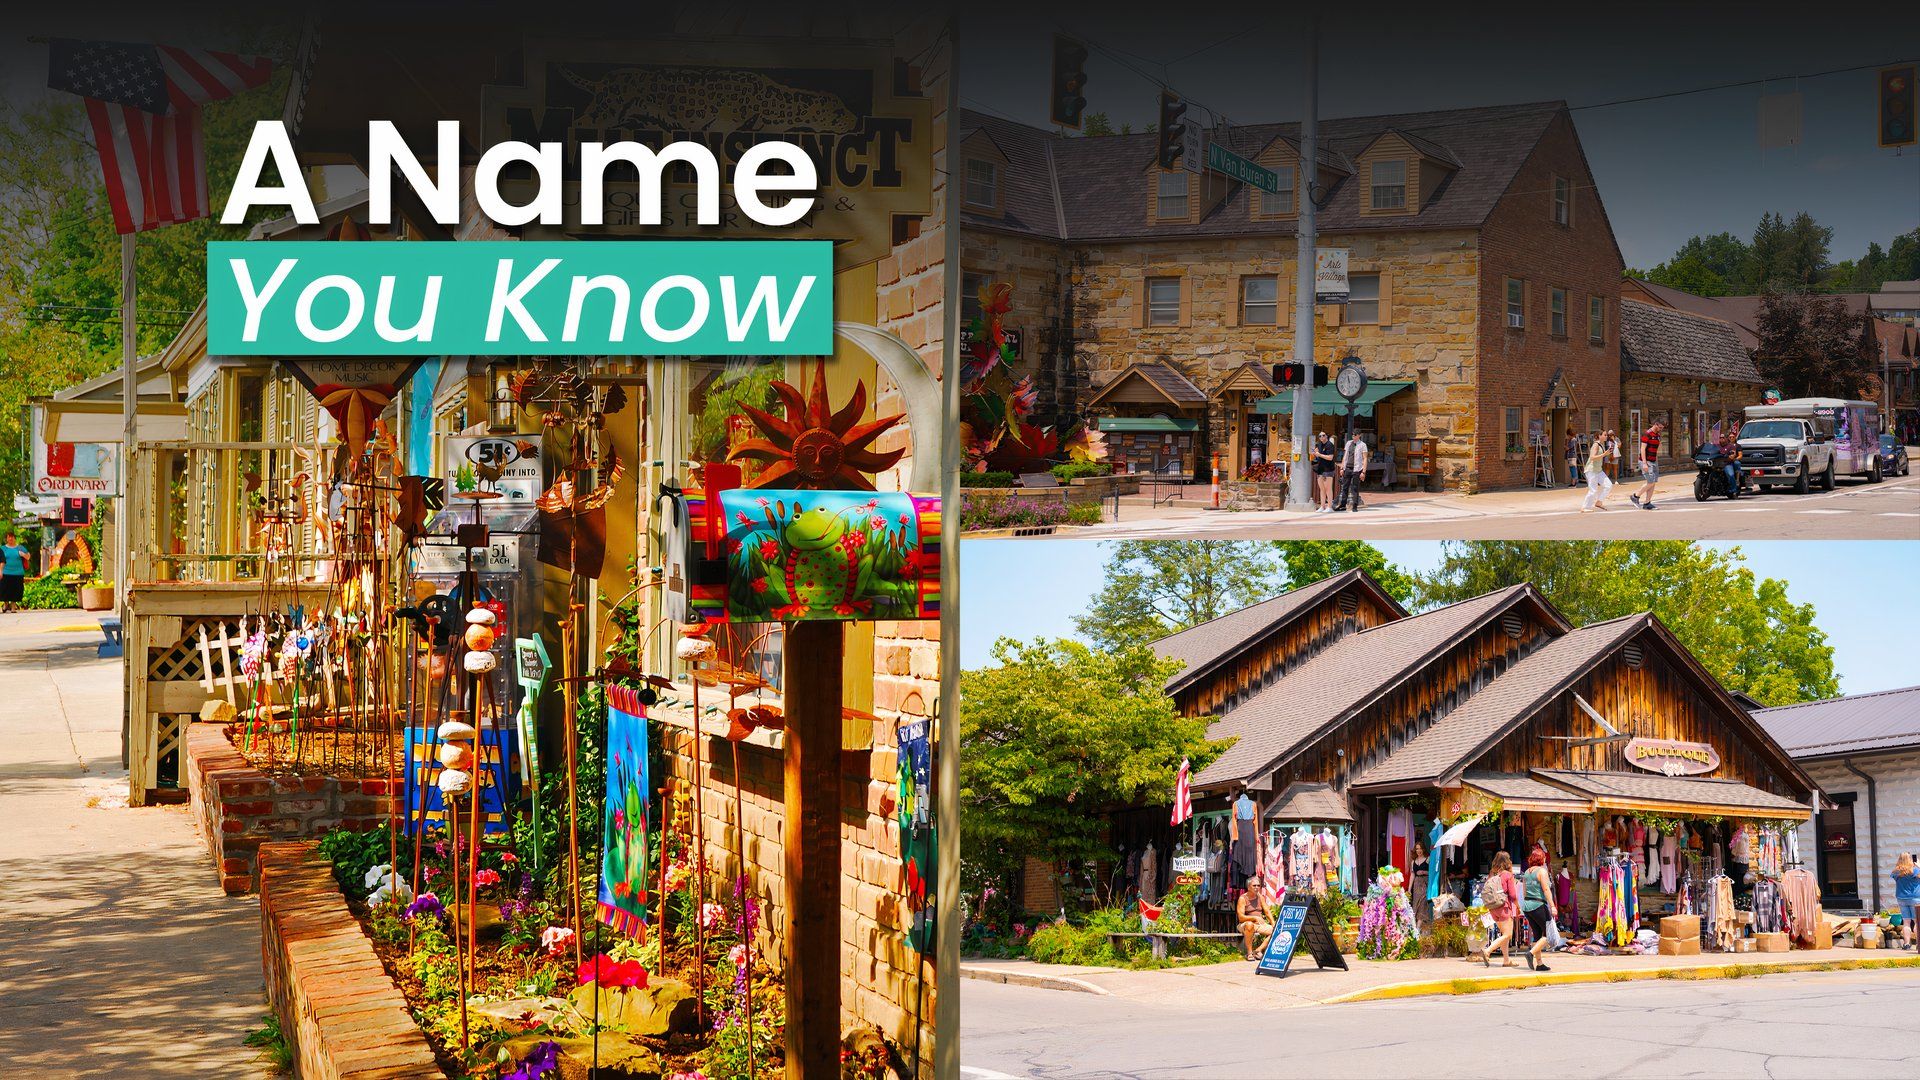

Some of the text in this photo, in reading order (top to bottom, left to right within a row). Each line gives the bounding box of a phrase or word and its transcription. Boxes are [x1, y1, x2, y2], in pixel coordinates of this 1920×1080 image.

[1210, 144, 1277, 192] N Van Buren St
[835, 196, 856, 211] &
[603, 210, 674, 226] GIFS
[685, 212, 739, 228] FR
[1322, 260, 1342, 269] Arts
[1318, 271, 1346, 283] Village
[311, 361, 396, 373] HOME DECOR
[334, 372, 374, 383] MUSIC
[37, 477, 109, 492] ORDINARY
[1635, 746, 1710, 766] BOUTIQUE
[1208, 899, 1235, 910] OPEN
